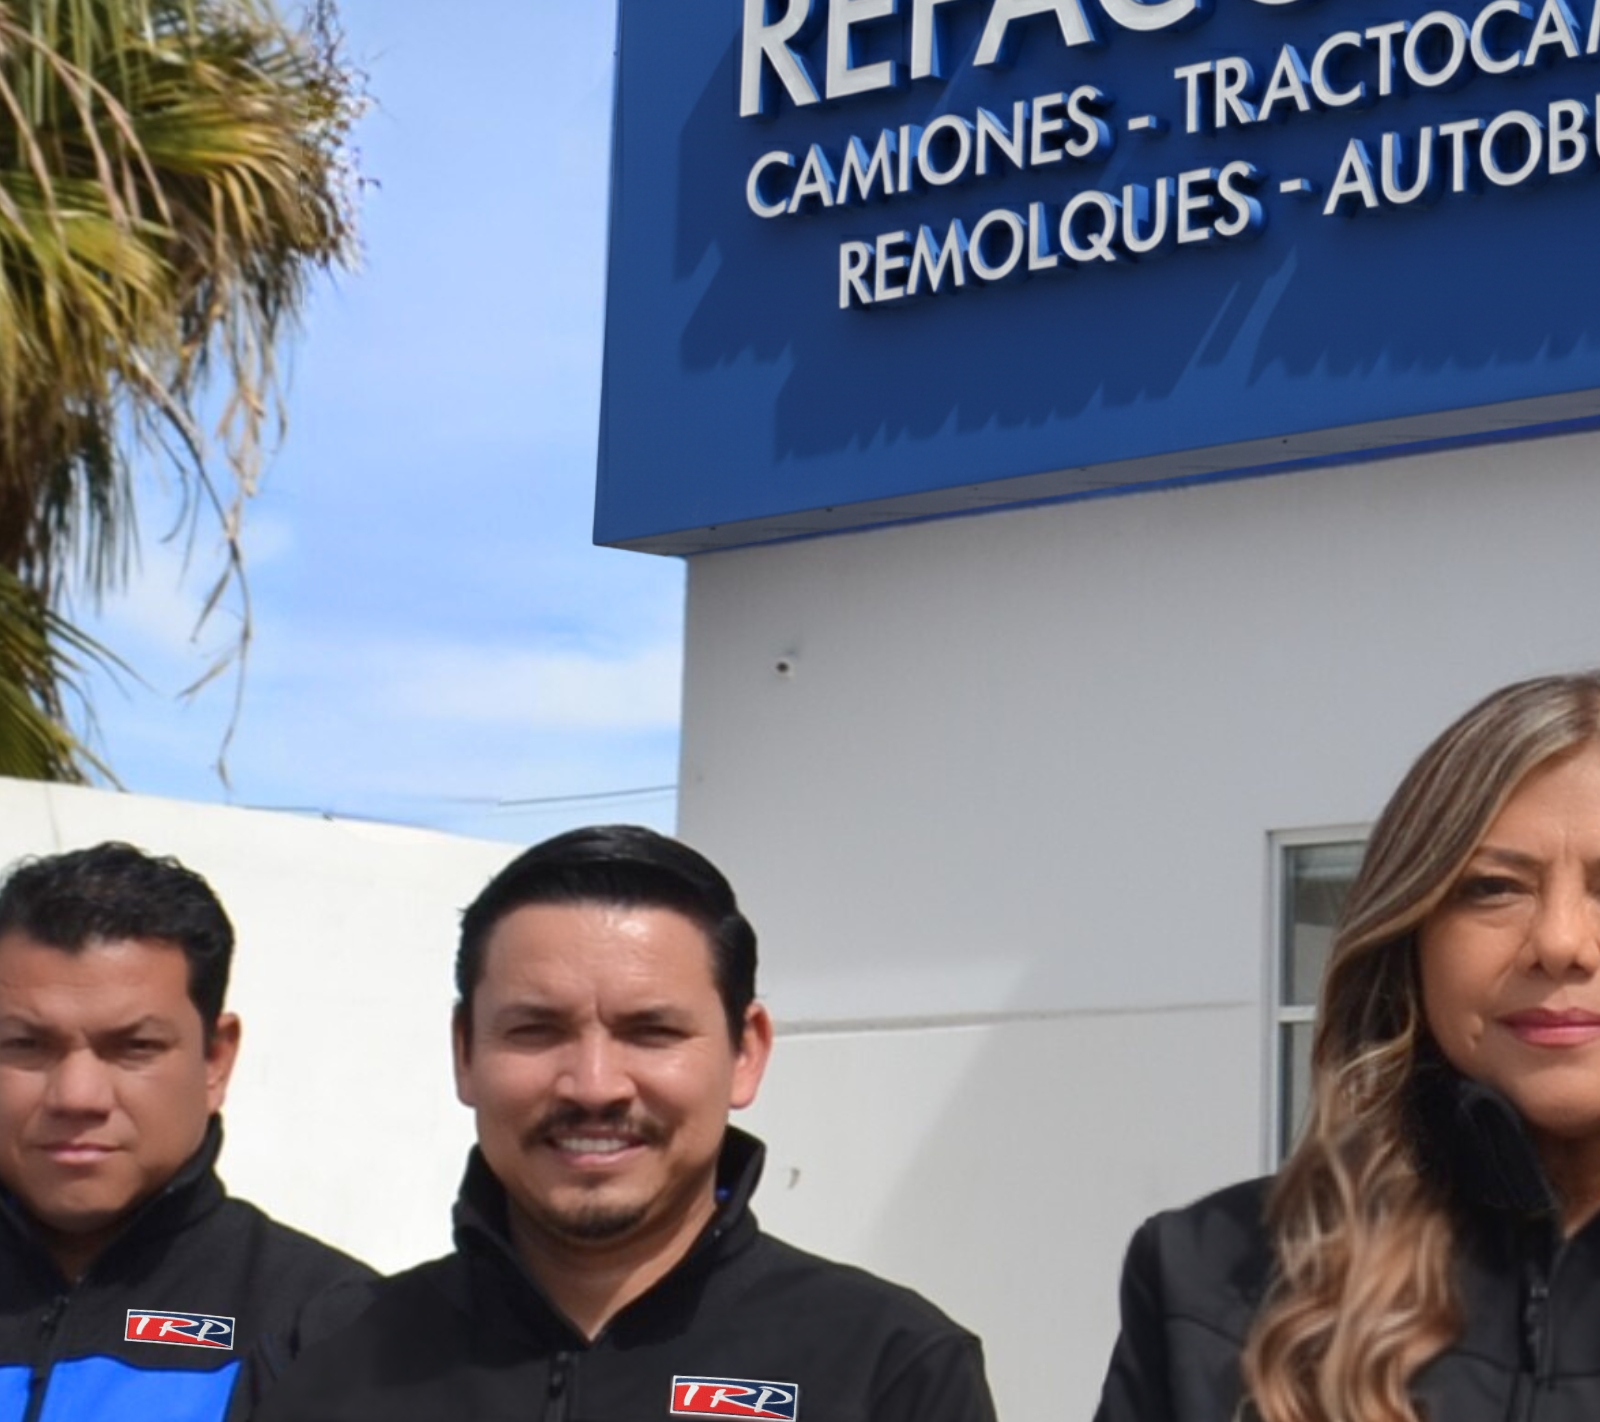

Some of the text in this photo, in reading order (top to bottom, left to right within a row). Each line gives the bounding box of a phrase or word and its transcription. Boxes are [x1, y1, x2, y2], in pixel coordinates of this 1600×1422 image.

[745, 84, 1100, 218] CAMIONES
[837, 160, 1253, 310] REMOLQUES
[128, 1313, 232, 1349] TRP
[675, 1381, 794, 1420] TRP
